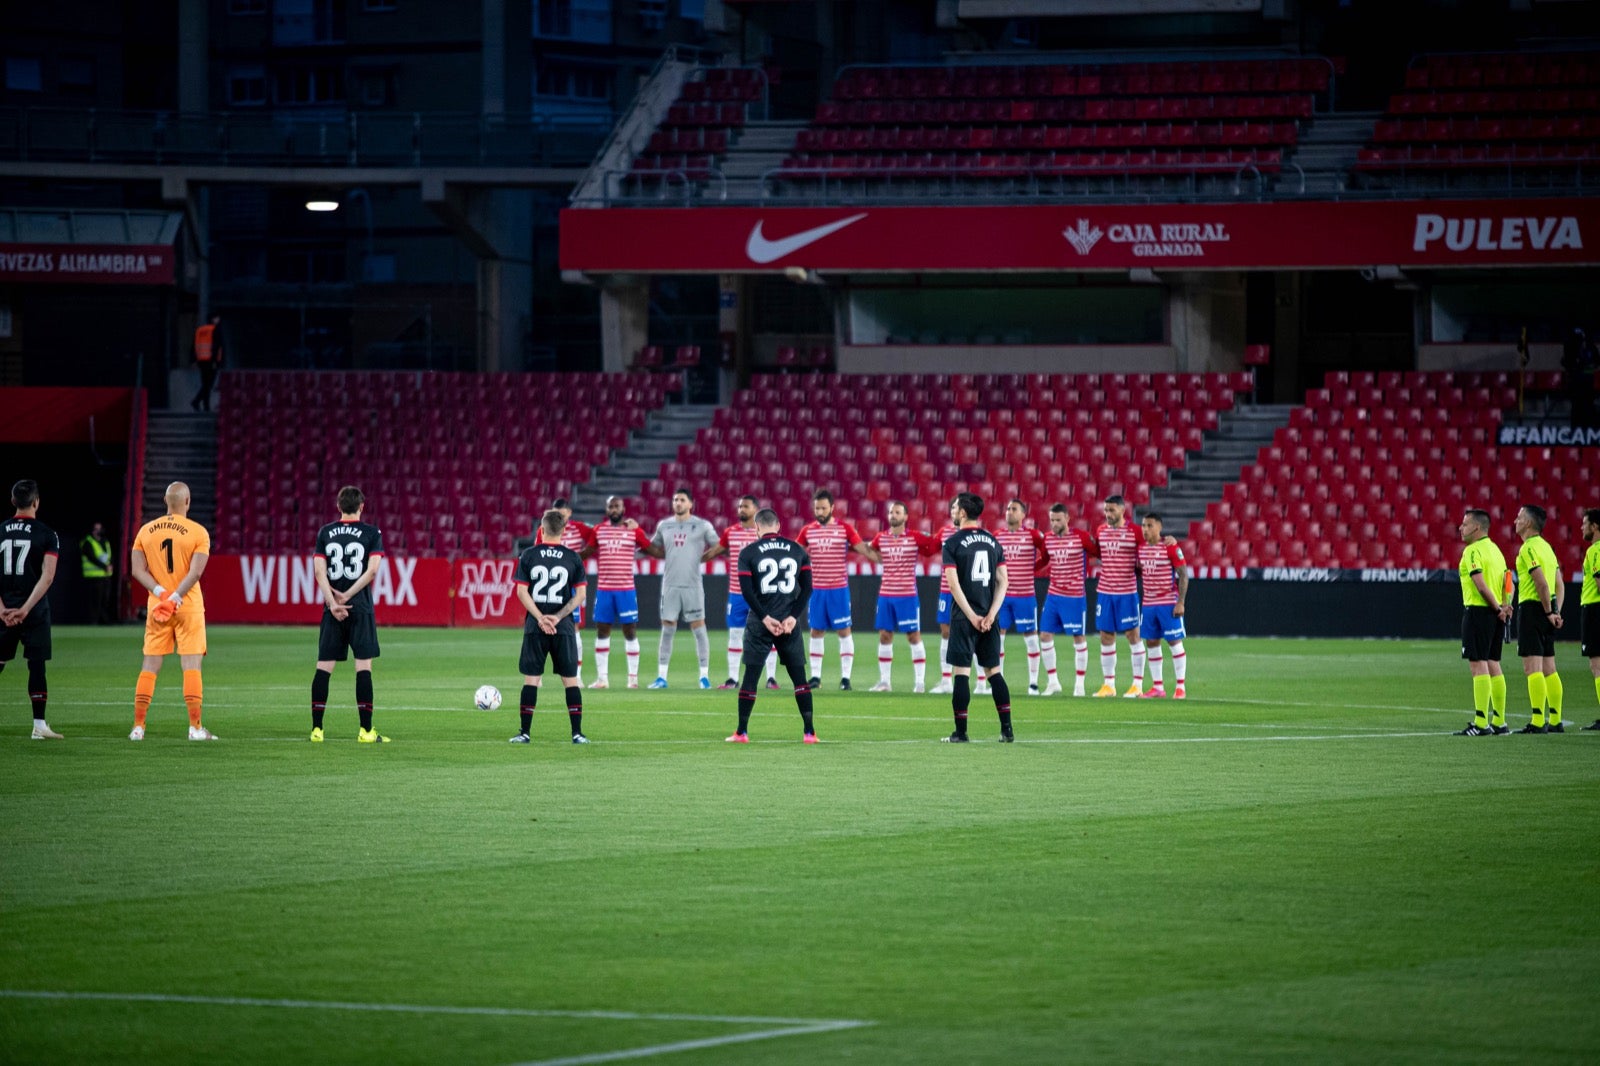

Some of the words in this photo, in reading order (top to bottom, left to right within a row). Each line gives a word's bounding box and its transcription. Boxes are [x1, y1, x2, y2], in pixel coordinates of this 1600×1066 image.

[1107, 223, 1157, 243] CAJA
[1160, 223, 1230, 242] RURAL
[1413, 213, 1583, 251] PULEVA
[1132, 243, 1204, 257] GRANADA
[58, 254, 147, 273] ALHAMBRA
[5, 523, 24, 532] KIKE
[148, 522, 188, 535] DMITROVIC
[328, 526, 363, 538] ATIENZA
[0, 539, 31, 575] 17
[160, 538, 174, 574] 1
[540, 549, 563, 559] POZO
[758, 541, 791, 553] ARBILLA
[325, 541, 365, 580] 33
[971, 550, 991, 587] 4
[239, 555, 418, 606] WINAX
[530, 565, 569, 604] 22
[757, 557, 798, 594] 23
[1361, 568, 1428, 582] #FANCAM
